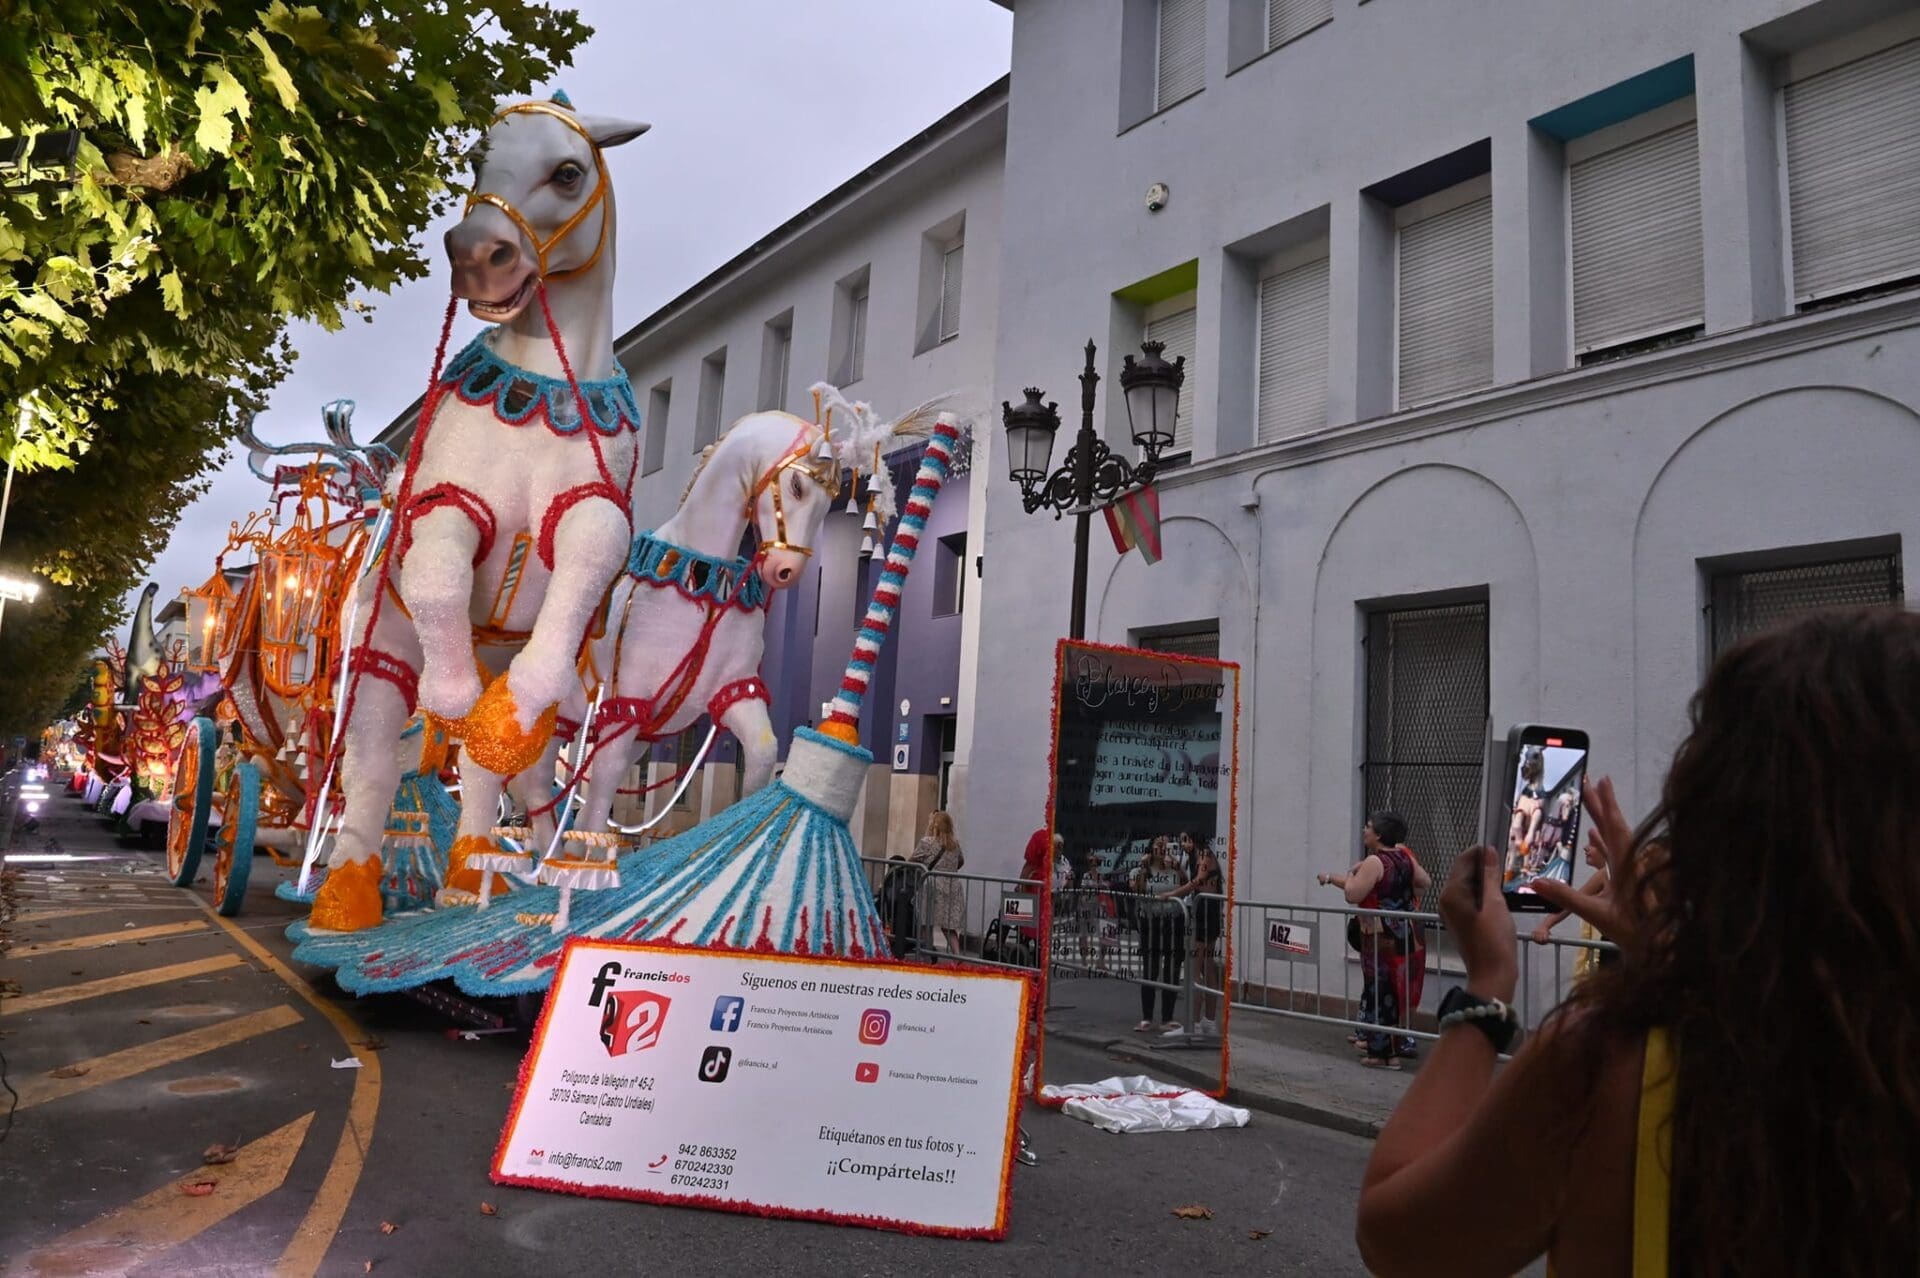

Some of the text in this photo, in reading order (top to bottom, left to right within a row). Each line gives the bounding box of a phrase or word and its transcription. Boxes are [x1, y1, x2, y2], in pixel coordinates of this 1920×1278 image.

[1122, 755, 1154, 768] través
[1158, 758, 1170, 771] de
[1095, 784, 1116, 796] gran
[1270, 923, 1291, 945] AGZ
[624, 968, 691, 984] francisdos
[800, 980, 817, 992] en
[820, 981, 874, 996] nuestras
[877, 984, 913, 1000] redes
[915, 987, 967, 1004] sociales
[777, 1007, 808, 1018] Proyectos
[771, 1022, 802, 1033] Proyectos
[590, 1072, 600, 1085] de
[638, 1076, 655, 1091] 45-2
[916, 1072, 947, 1083] Proyectos
[549, 1088, 571, 1103] 39709
[597, 1093, 624, 1109] (Castro
[624, 1095, 656, 1114] Urdiales)
[579, 1111, 613, 1127] Cantabria
[818, 1126, 886, 1146] Etiquétanos
[887, 1136, 902, 1148] en
[905, 1136, 923, 1150] tus
[925, 1135, 955, 1153] fotos
[956, 1143, 964, 1158] y
[678, 1143, 737, 1161] 942 863352
[548, 1151, 623, 1172] info@francis2.com
[674, 1159, 734, 1176] 670242330
[826, 1157, 956, 1184] ¡¡Compártelas!!
[670, 1174, 730, 1190] 670242331
